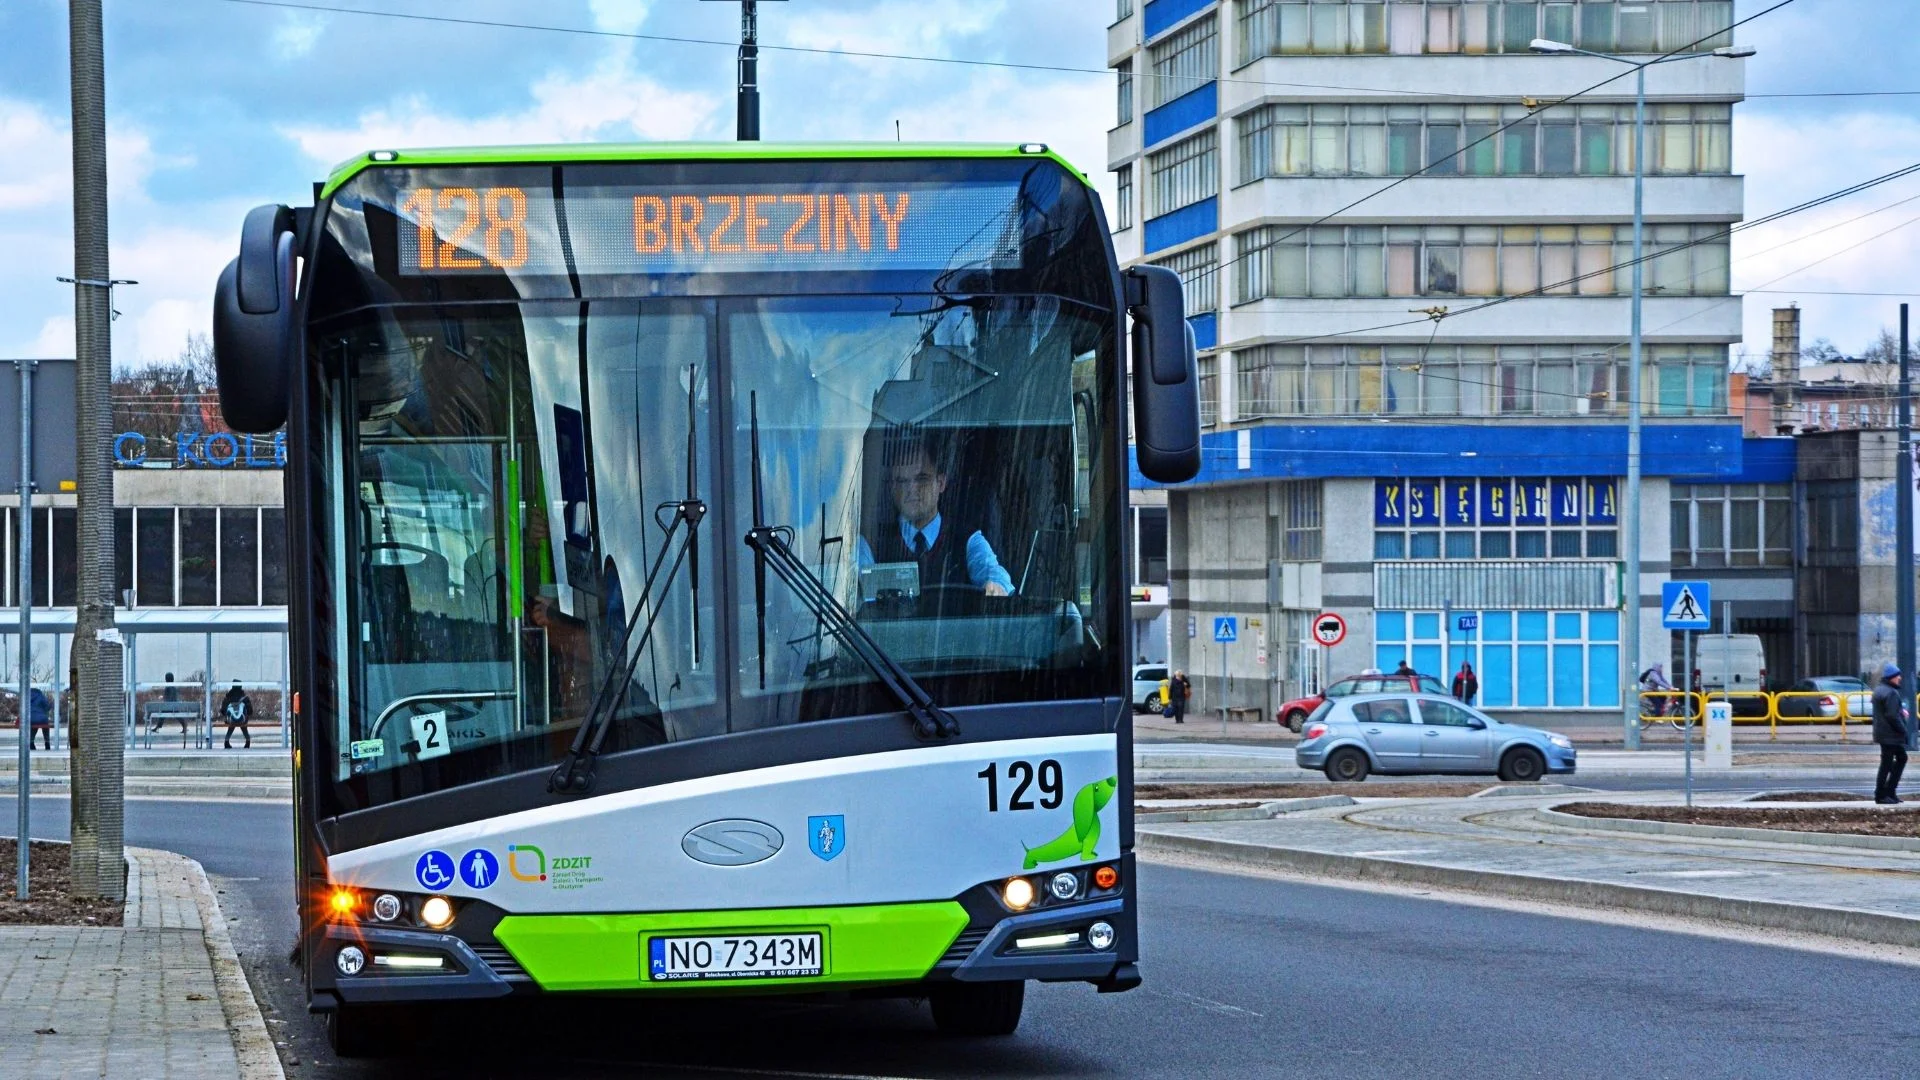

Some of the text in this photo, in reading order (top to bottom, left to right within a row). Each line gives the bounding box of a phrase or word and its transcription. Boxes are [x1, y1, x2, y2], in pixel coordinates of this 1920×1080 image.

[402, 187, 910, 269] 128 BRZEZINY
[114, 432, 146, 466] C
[1384, 484, 1616, 522] KSIĘGARNIA
[423, 719, 440, 749] 2
[977, 759, 1064, 812] 129
[653, 960, 664, 968] PL
[670, 937, 815, 969] NO 7343M
